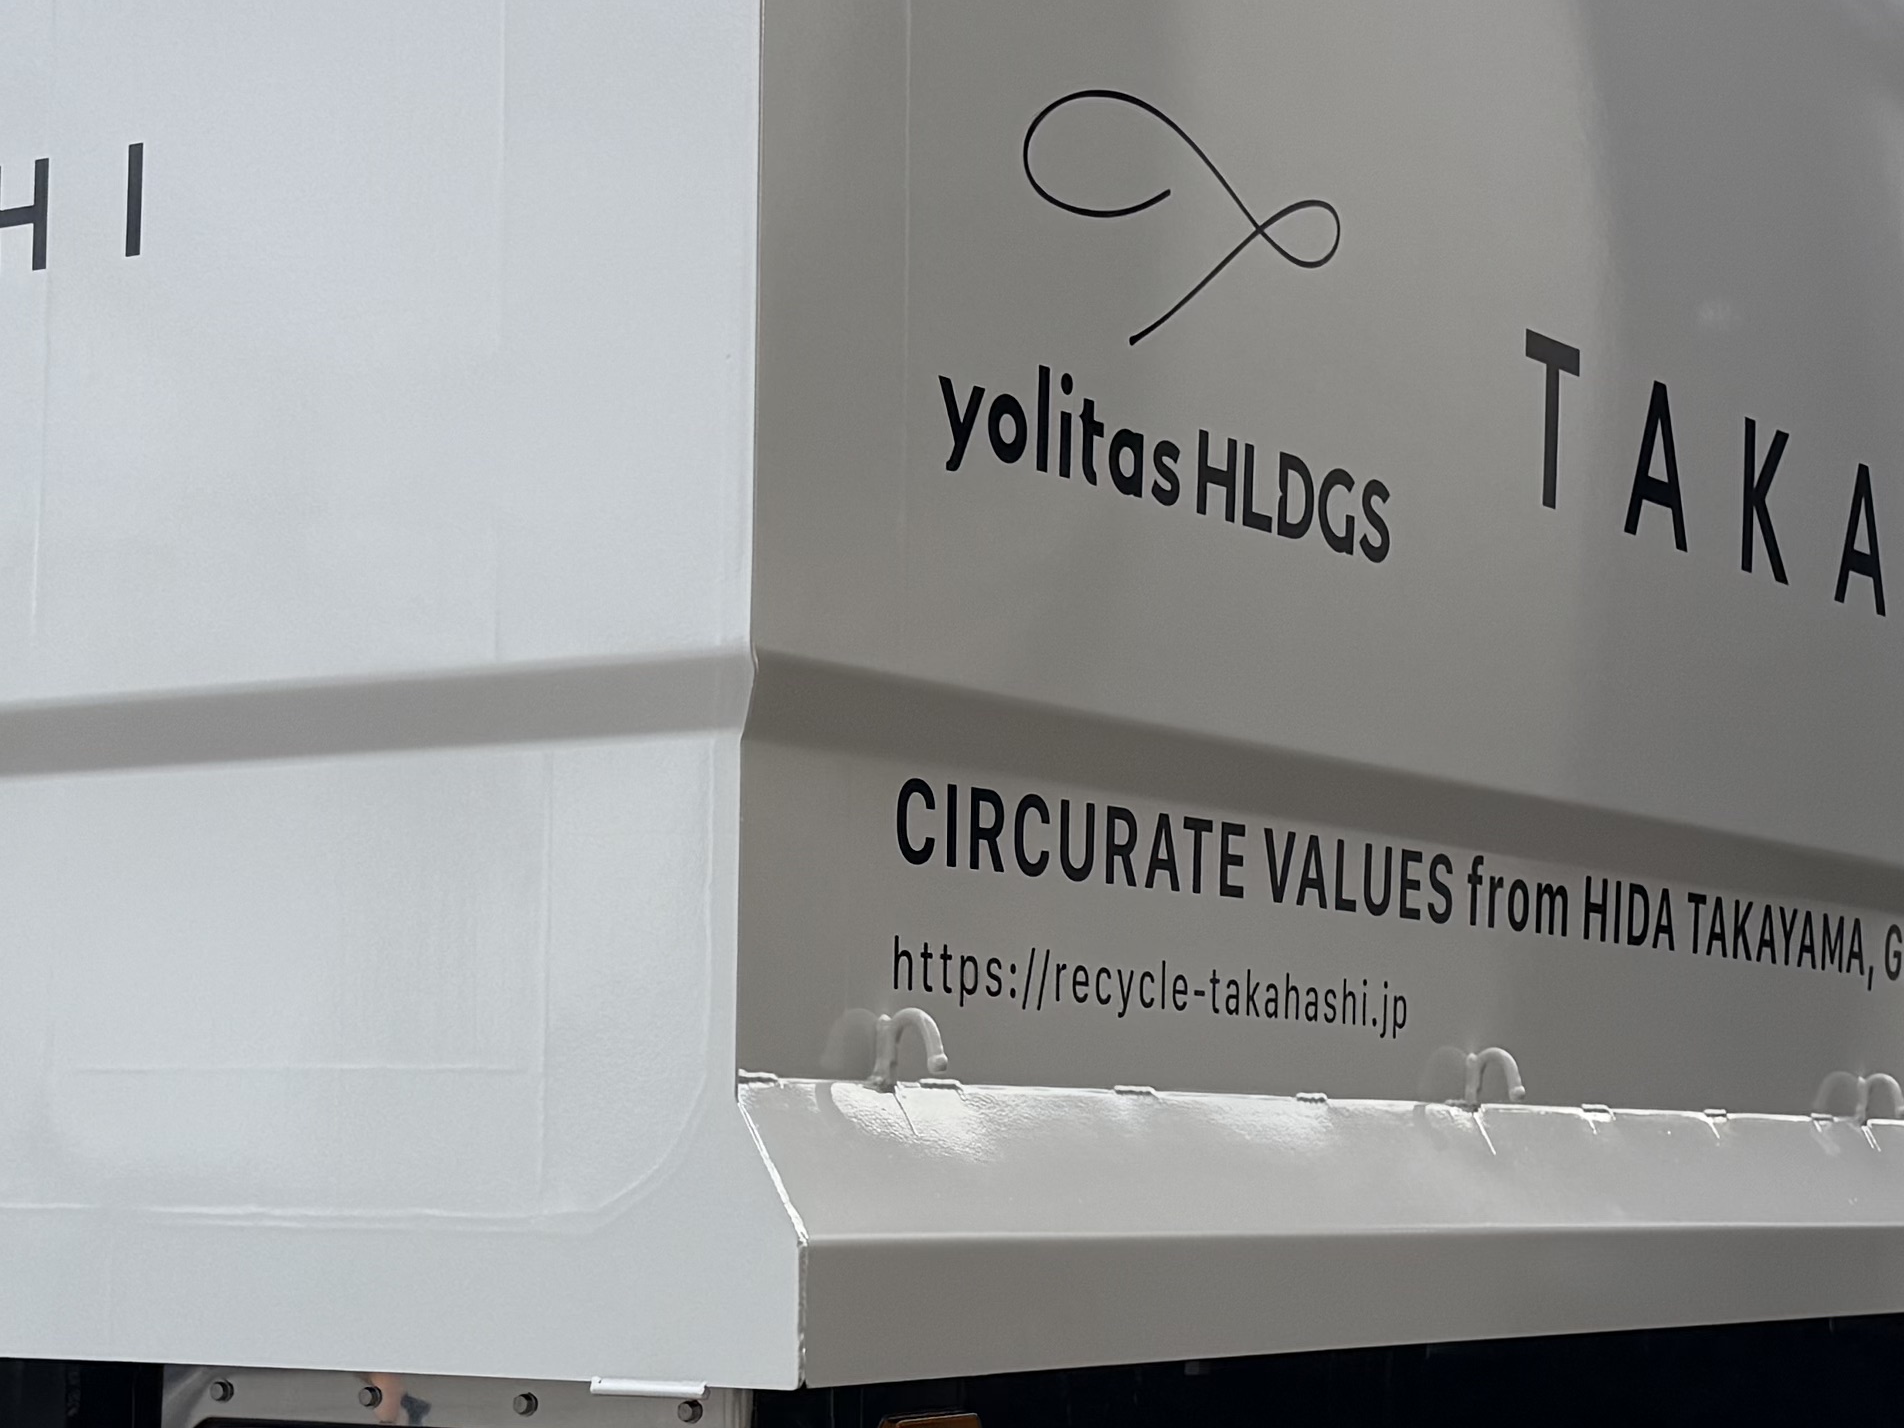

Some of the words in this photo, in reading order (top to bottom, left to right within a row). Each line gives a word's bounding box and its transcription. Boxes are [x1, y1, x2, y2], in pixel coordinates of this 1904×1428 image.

[896, 777, 1246, 899] CIRCURATE
[1263, 827, 1454, 925] VALUES
[1467, 854, 1569, 938] from
[1583, 875, 1675, 952] HIDA
[1687, 891, 1874, 992] TAKAYAMA,
[893, 934, 1407, 1040] https://recycle-takahashi.jp
